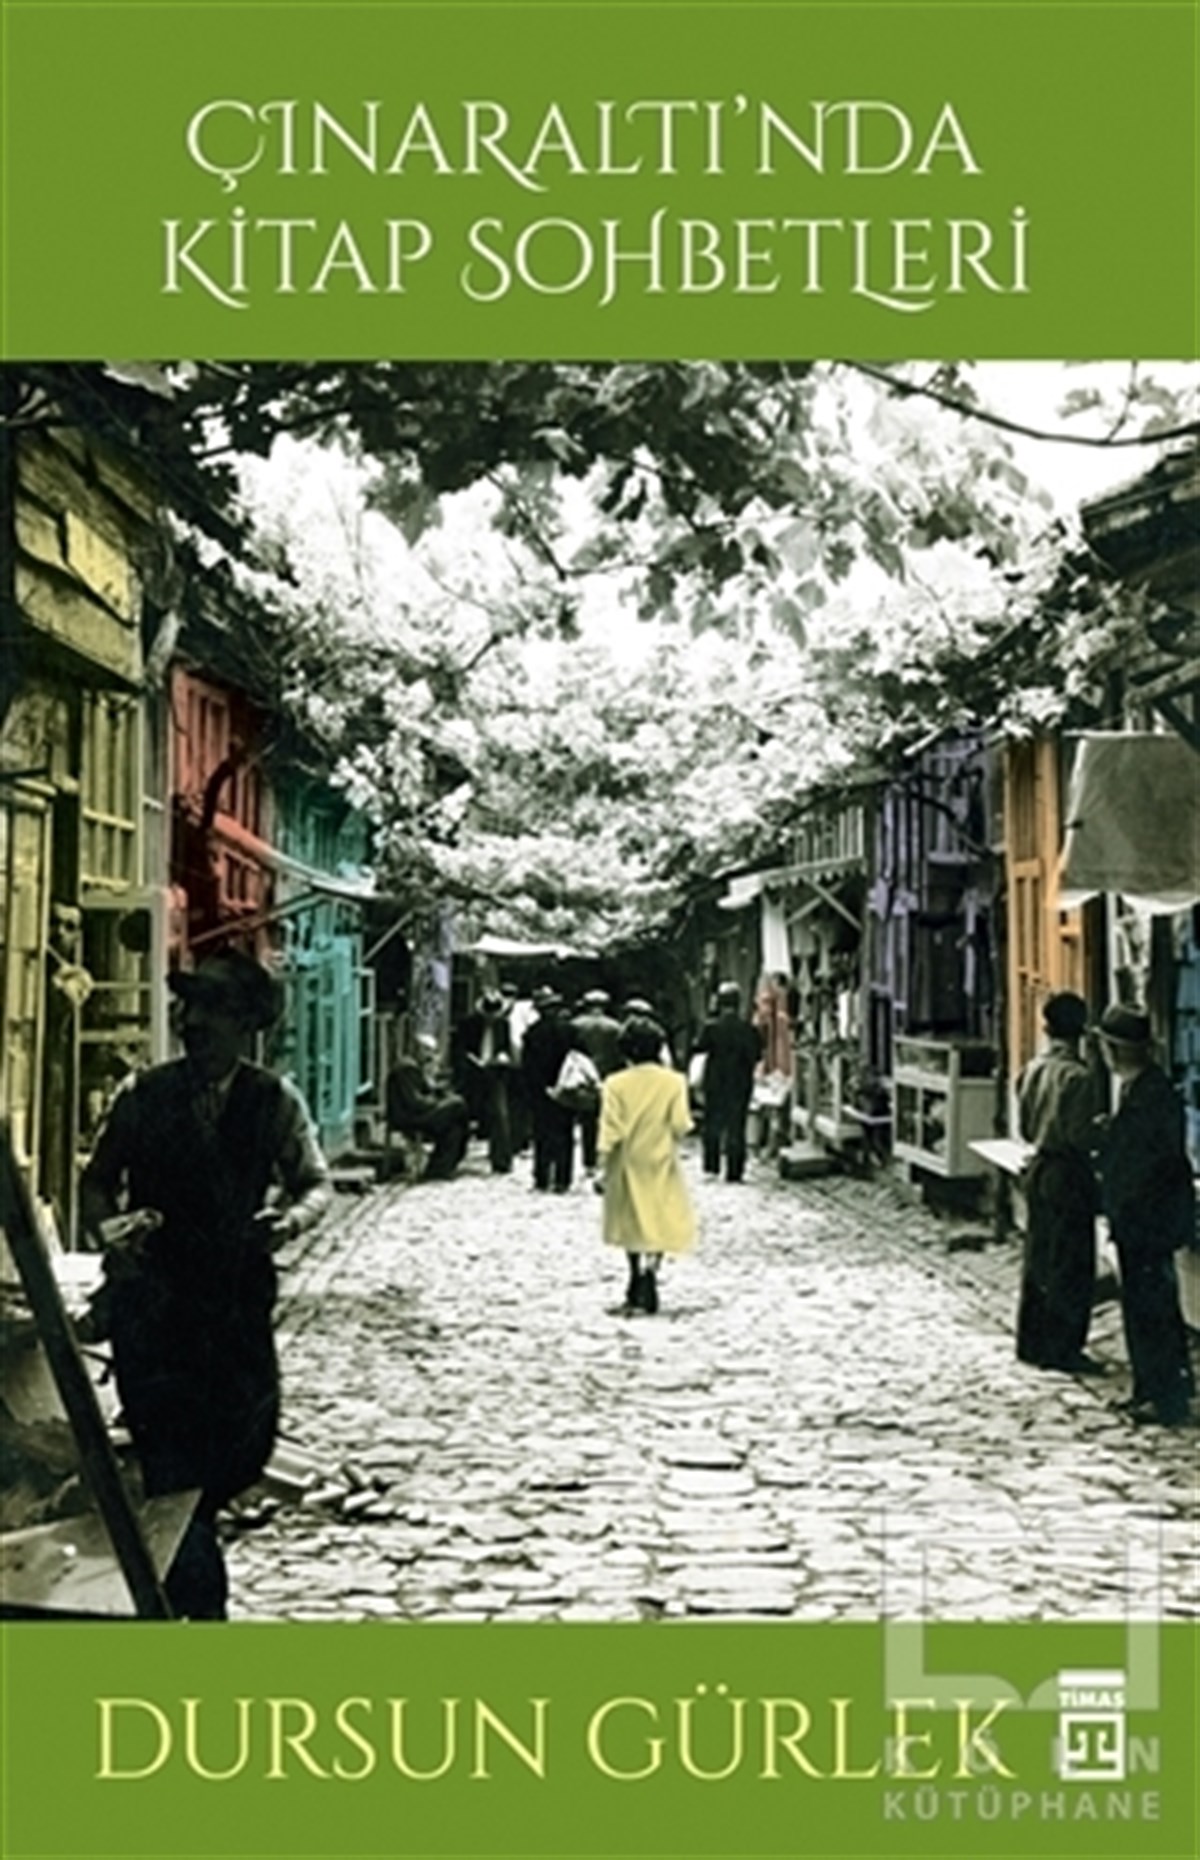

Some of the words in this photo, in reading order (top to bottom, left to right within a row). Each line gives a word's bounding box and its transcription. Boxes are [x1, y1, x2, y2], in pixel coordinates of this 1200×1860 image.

[161, 205, 433, 310] KİTAP
[461, 205, 1031, 313] SOHBETLERİ
[96, 1697, 549, 1780] DURSUN
[587, 1683, 1018, 1780] GÜRLEK
